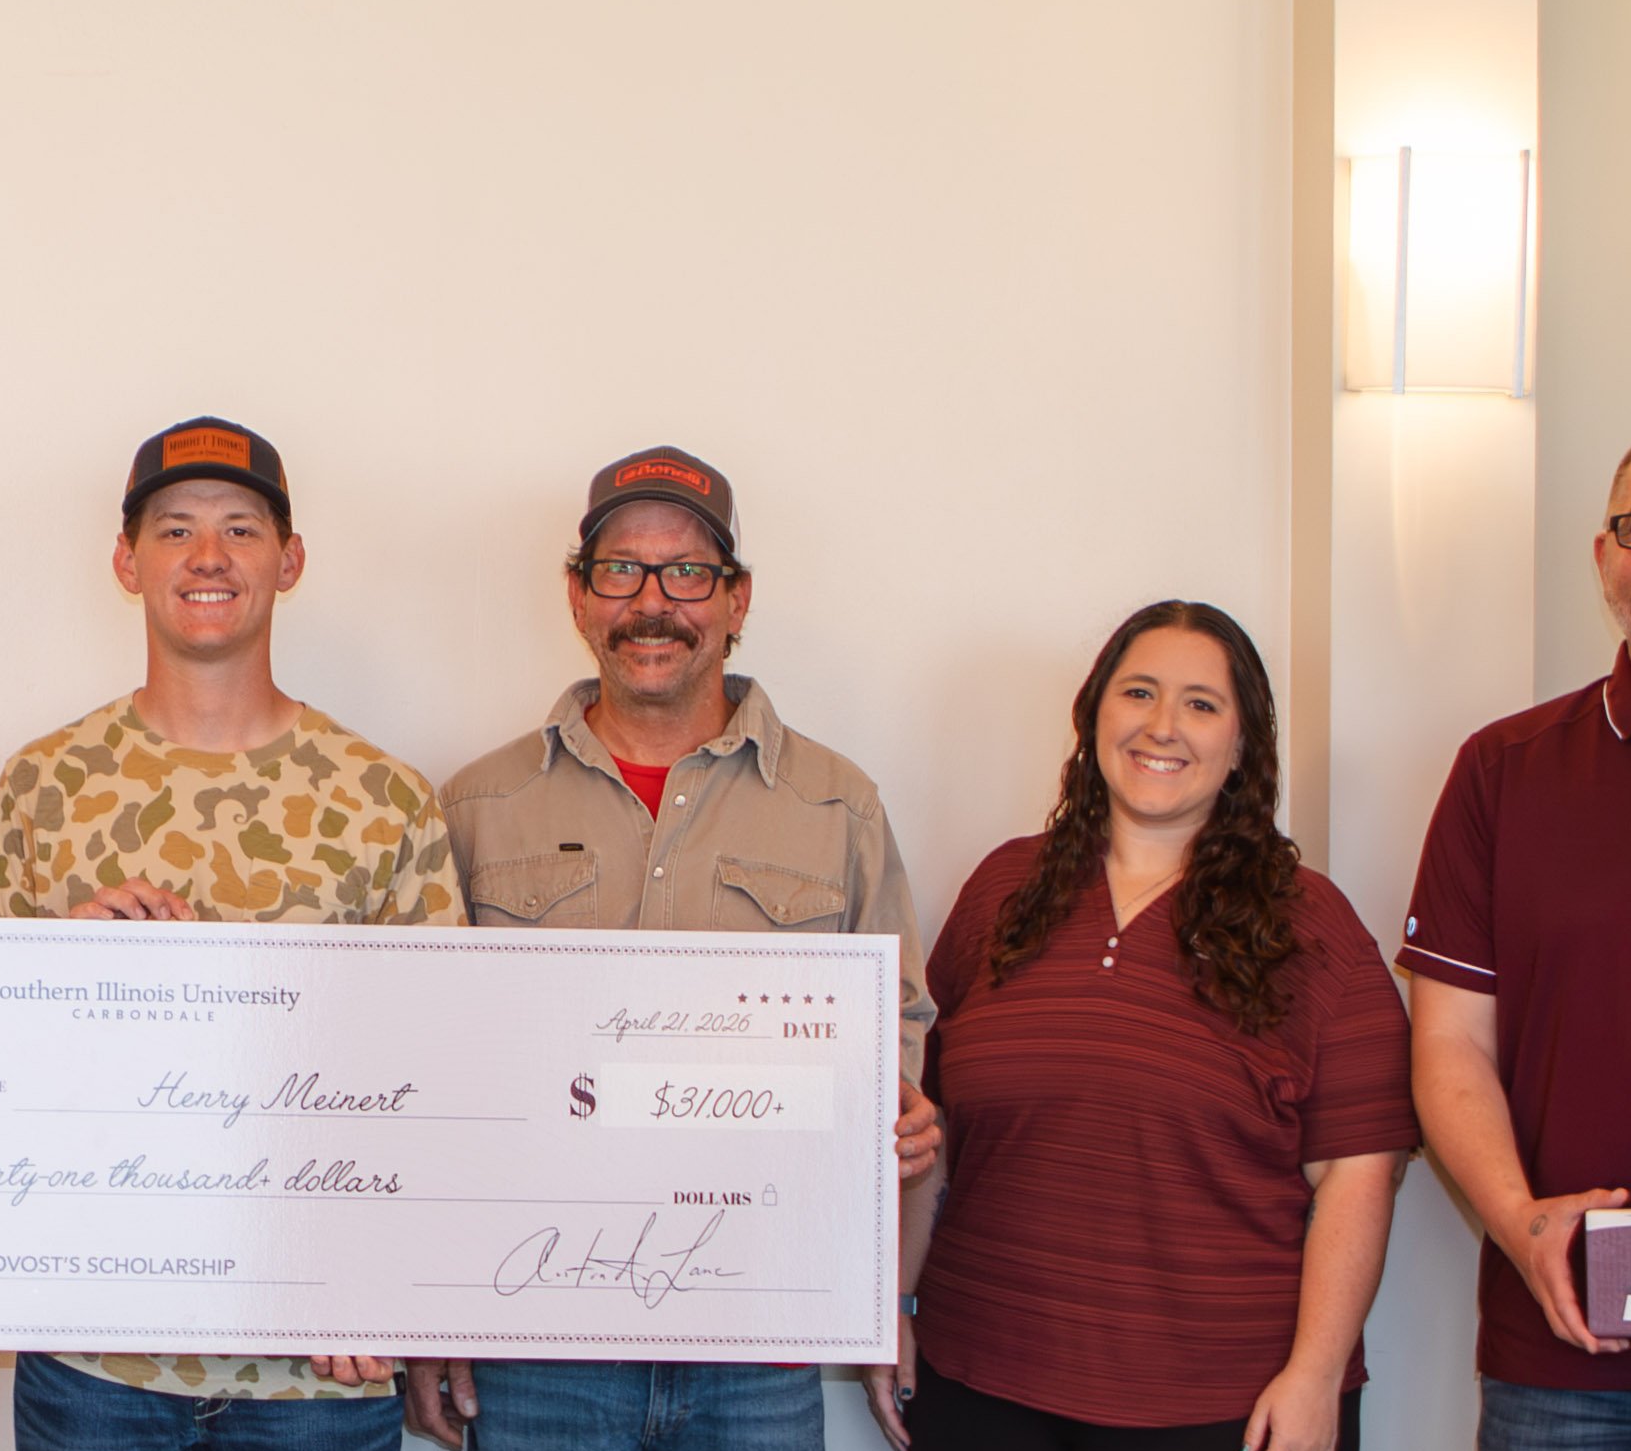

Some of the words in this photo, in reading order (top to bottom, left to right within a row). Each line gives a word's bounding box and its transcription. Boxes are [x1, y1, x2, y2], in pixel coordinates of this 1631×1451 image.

[95, 981, 175, 1004] Illinois
[183, 983, 302, 1012] University
[72, 1008, 216, 1022] CARBONDALE
[596, 1008, 661, 1043] April
[695, 1012, 753, 1032] 2026
[782, 1021, 837, 1040] DATE
[137, 1069, 248, 1129] Henry
[260, 1072, 419, 1113] Meinert
[569, 1072, 597, 1120] $
[108, 1154, 271, 1190] thousand+
[283, 1159, 403, 1194] dollars
[673, 1191, 752, 1206] DOLLARS
[86, 1256, 236, 1277] SCHOLARSHIP
